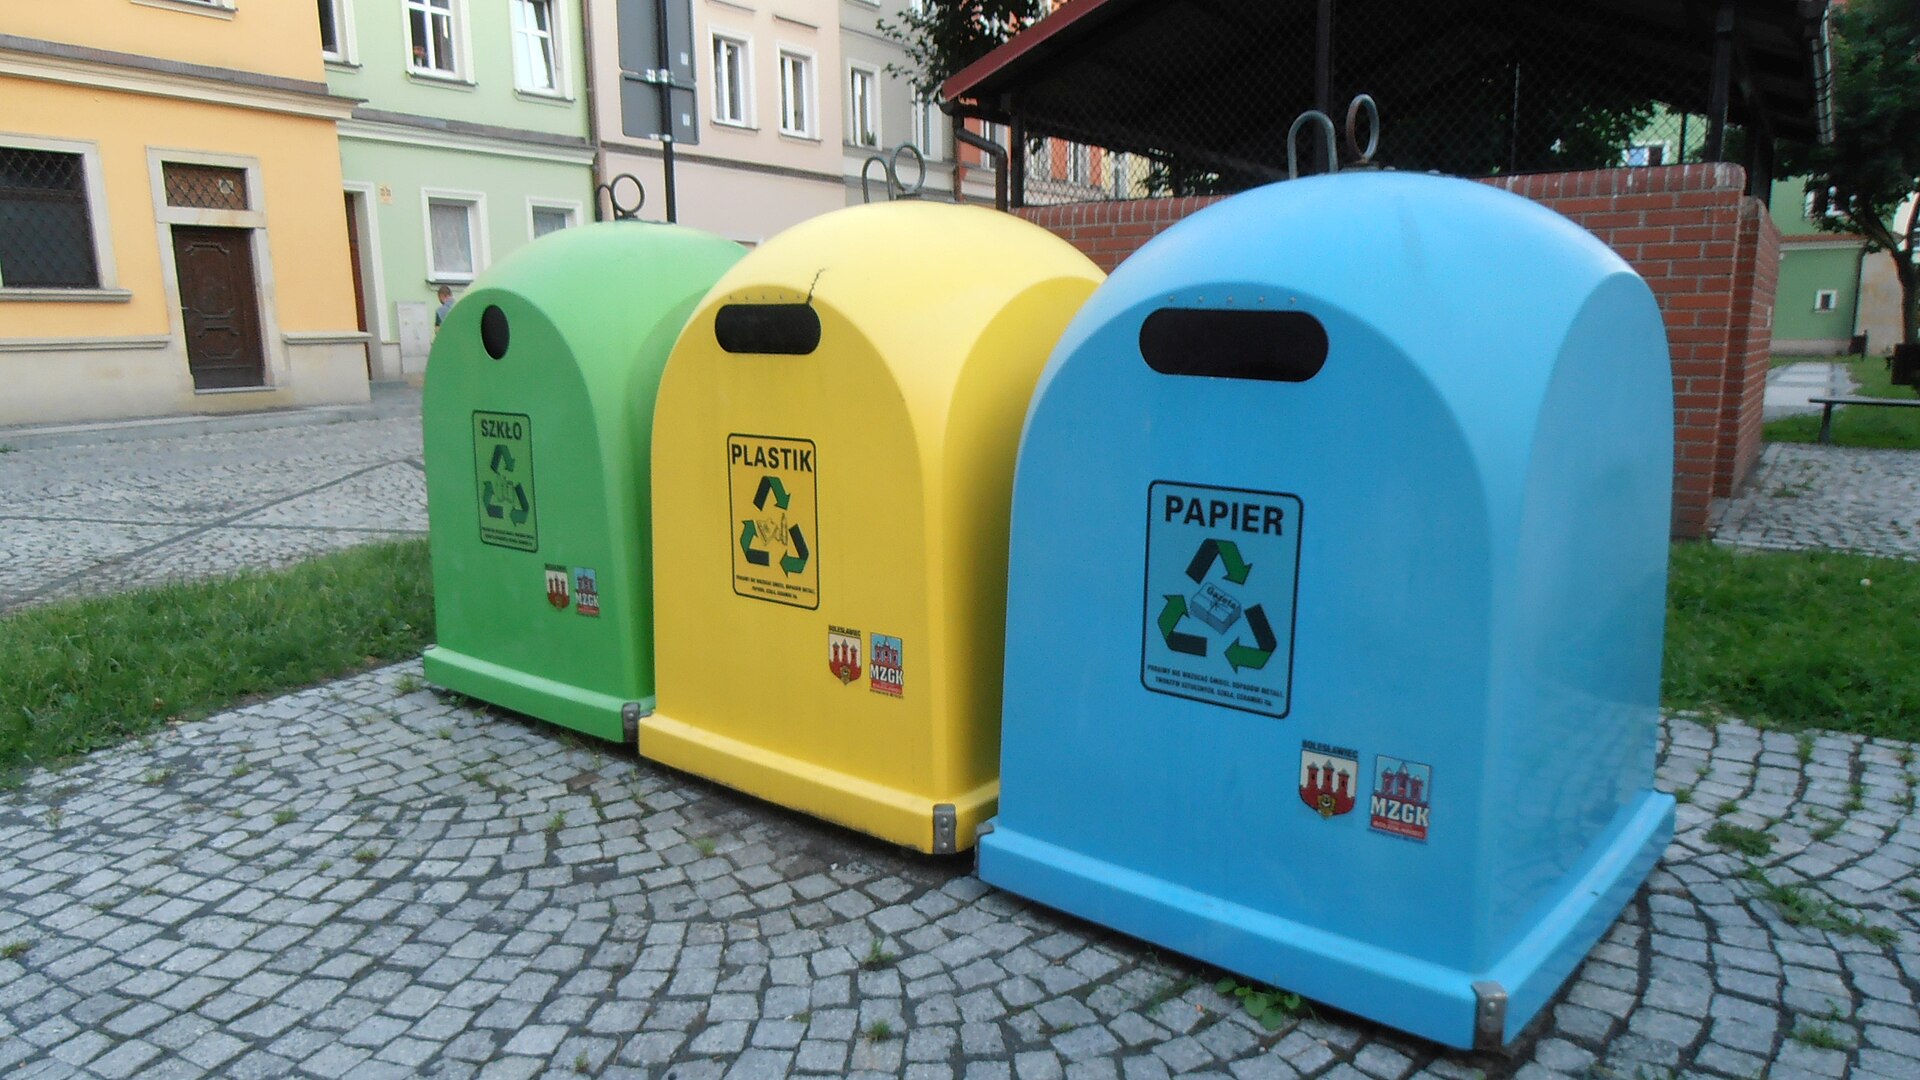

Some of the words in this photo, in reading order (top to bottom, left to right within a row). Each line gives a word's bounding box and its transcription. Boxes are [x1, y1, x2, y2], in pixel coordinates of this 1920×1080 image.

[481, 419, 522, 440] SZKŁO
[731, 443, 812, 473] PLASTIK
[1165, 494, 1284, 536] PAPIER
[870, 663, 904, 686] MZGK
[1370, 795, 1430, 828] MZGK
